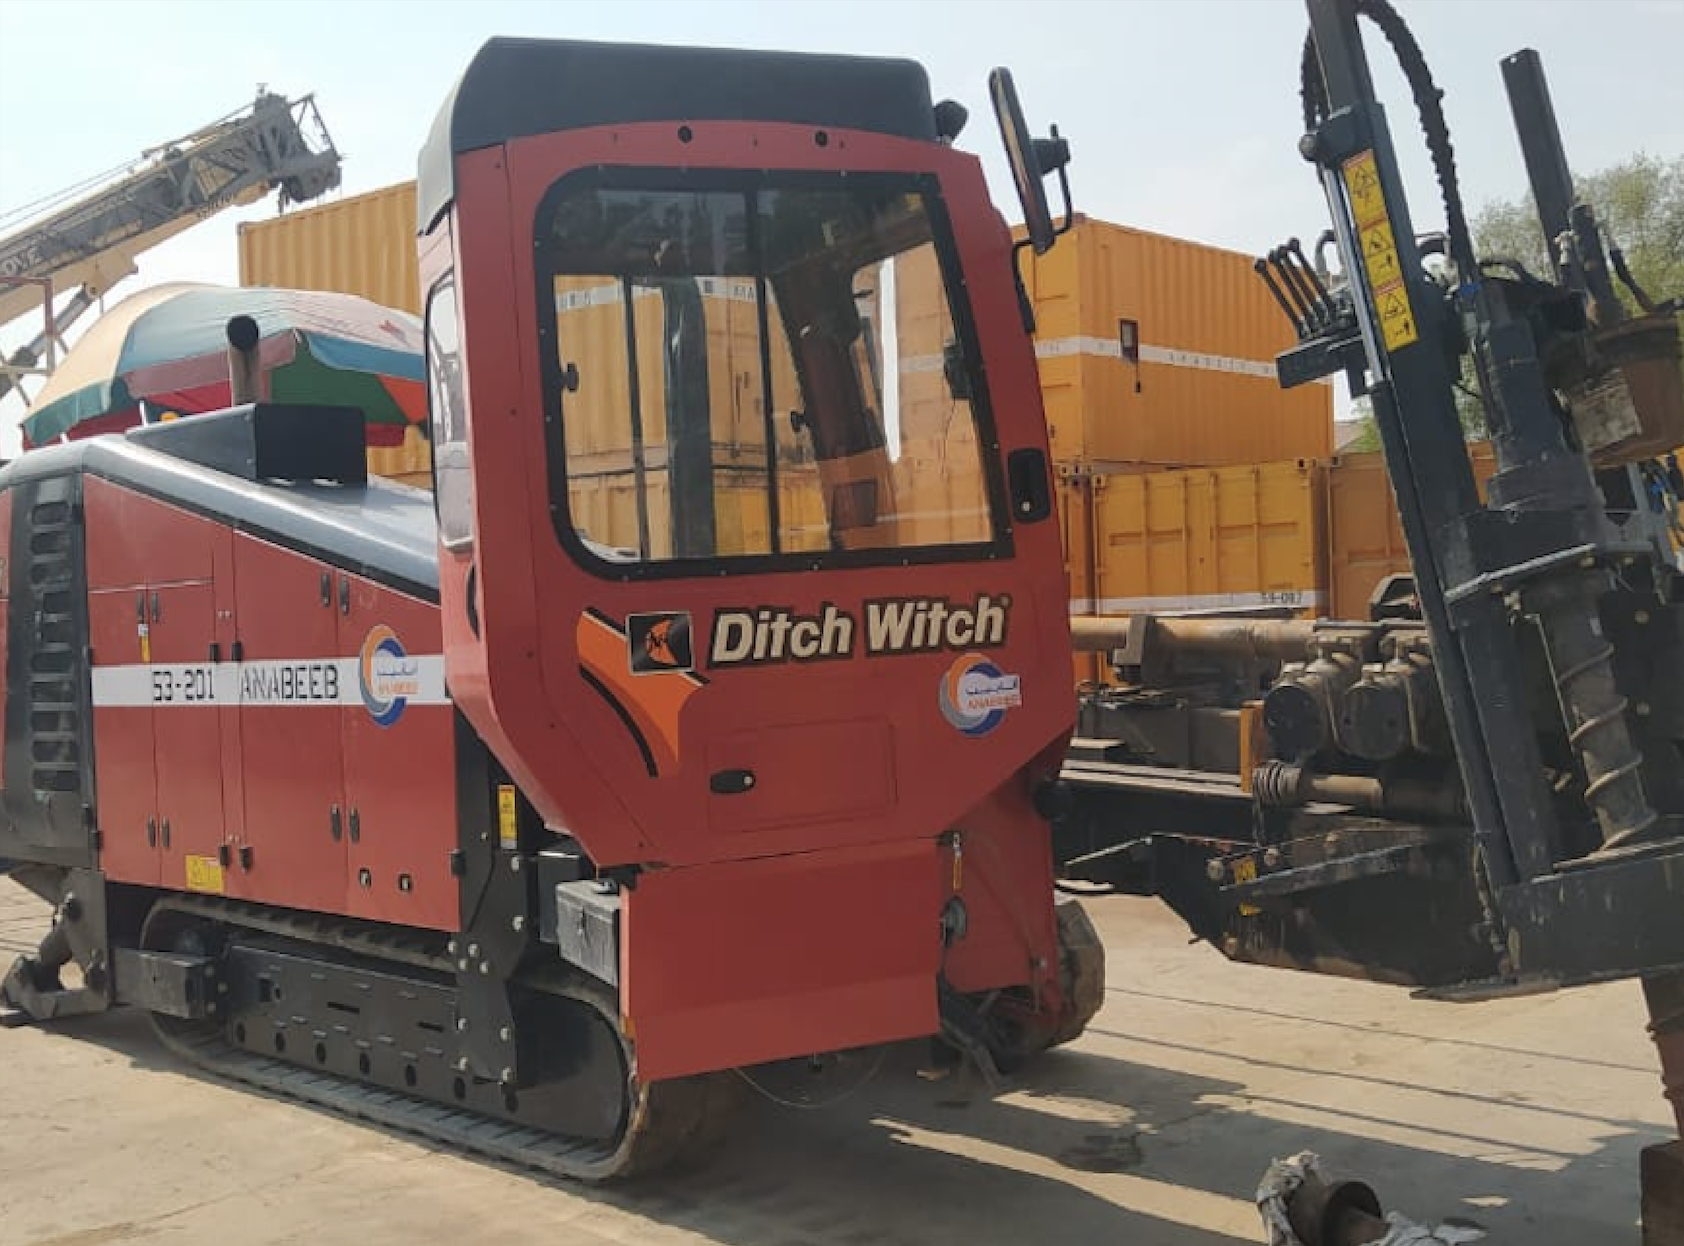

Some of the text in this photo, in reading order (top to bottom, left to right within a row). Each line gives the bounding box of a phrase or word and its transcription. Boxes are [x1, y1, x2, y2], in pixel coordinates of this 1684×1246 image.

[710, 595, 1006, 664] Ditch Witch
[152, 668, 215, 701] 53-201
[240, 664, 339, 700] ANABEEB
